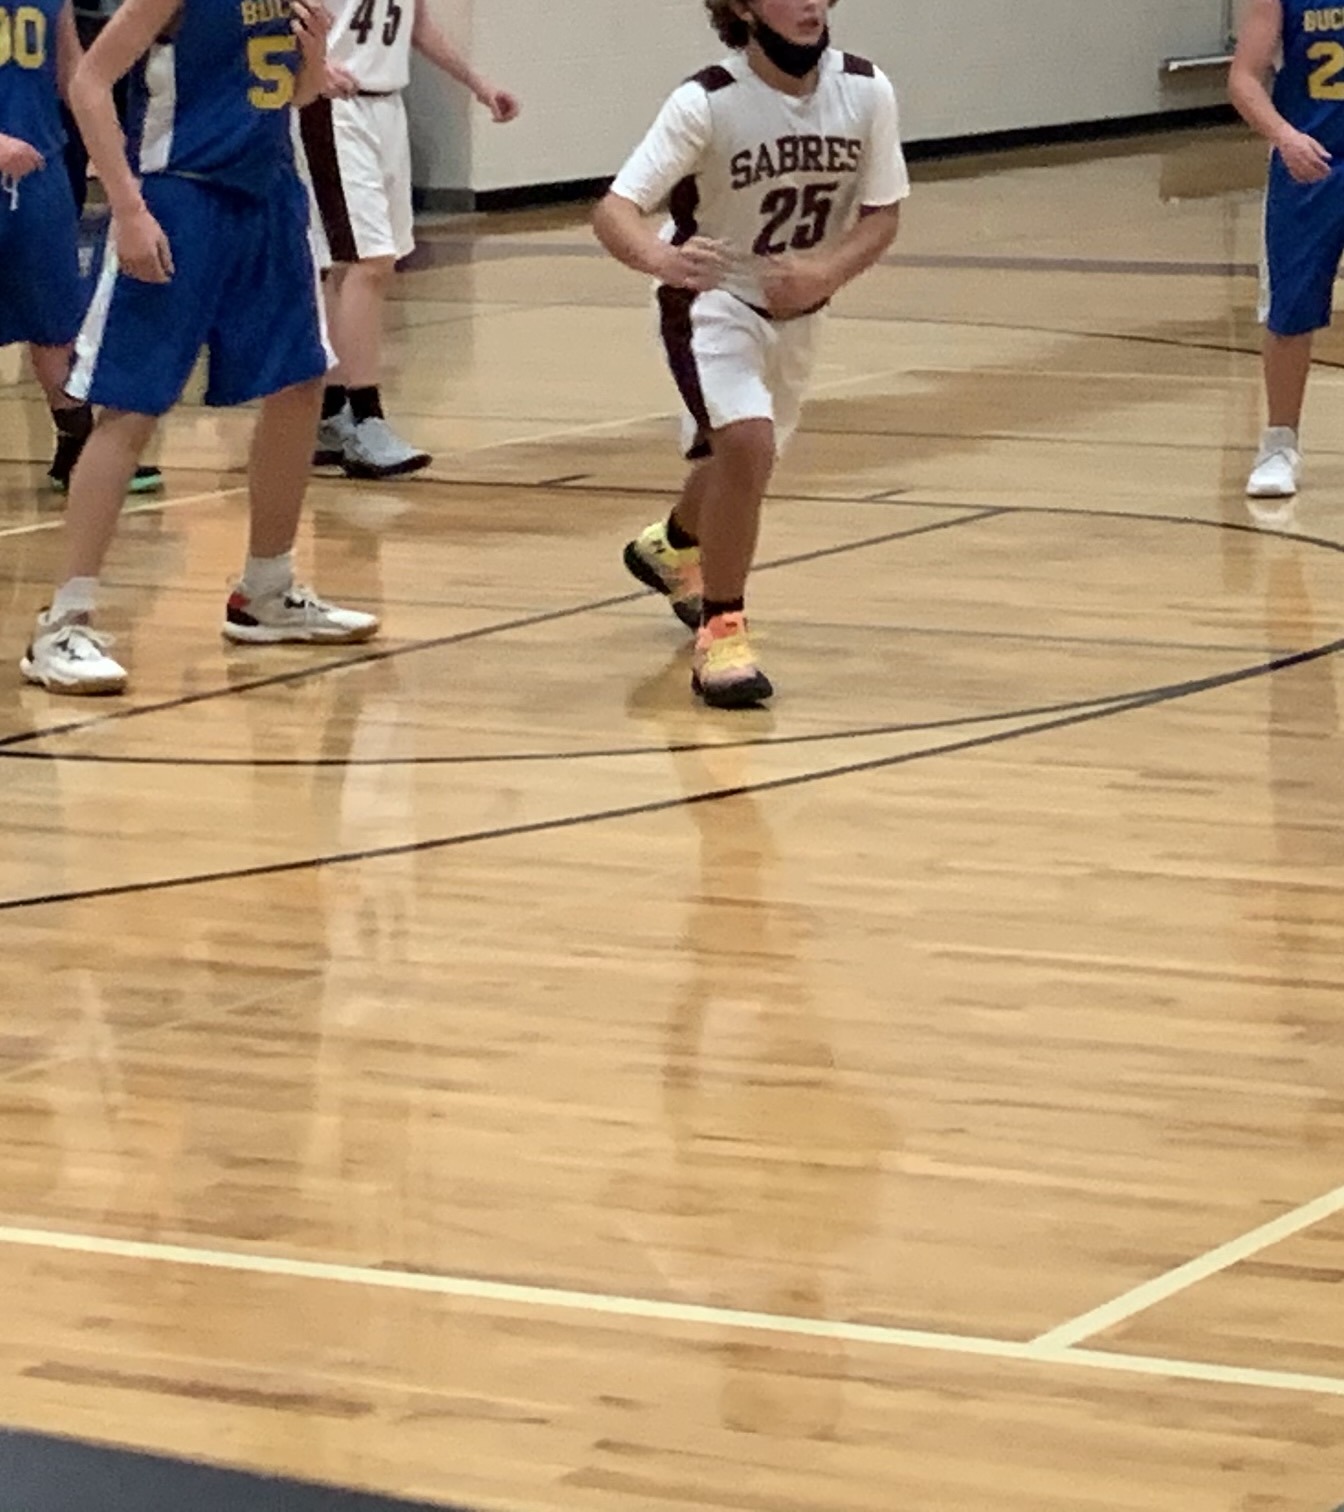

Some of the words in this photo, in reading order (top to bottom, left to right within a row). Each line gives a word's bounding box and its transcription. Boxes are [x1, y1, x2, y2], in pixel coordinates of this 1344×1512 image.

[247, 34, 296, 109] 5
[730, 134, 862, 190] SABRES
[752, 181, 840, 257] 25
